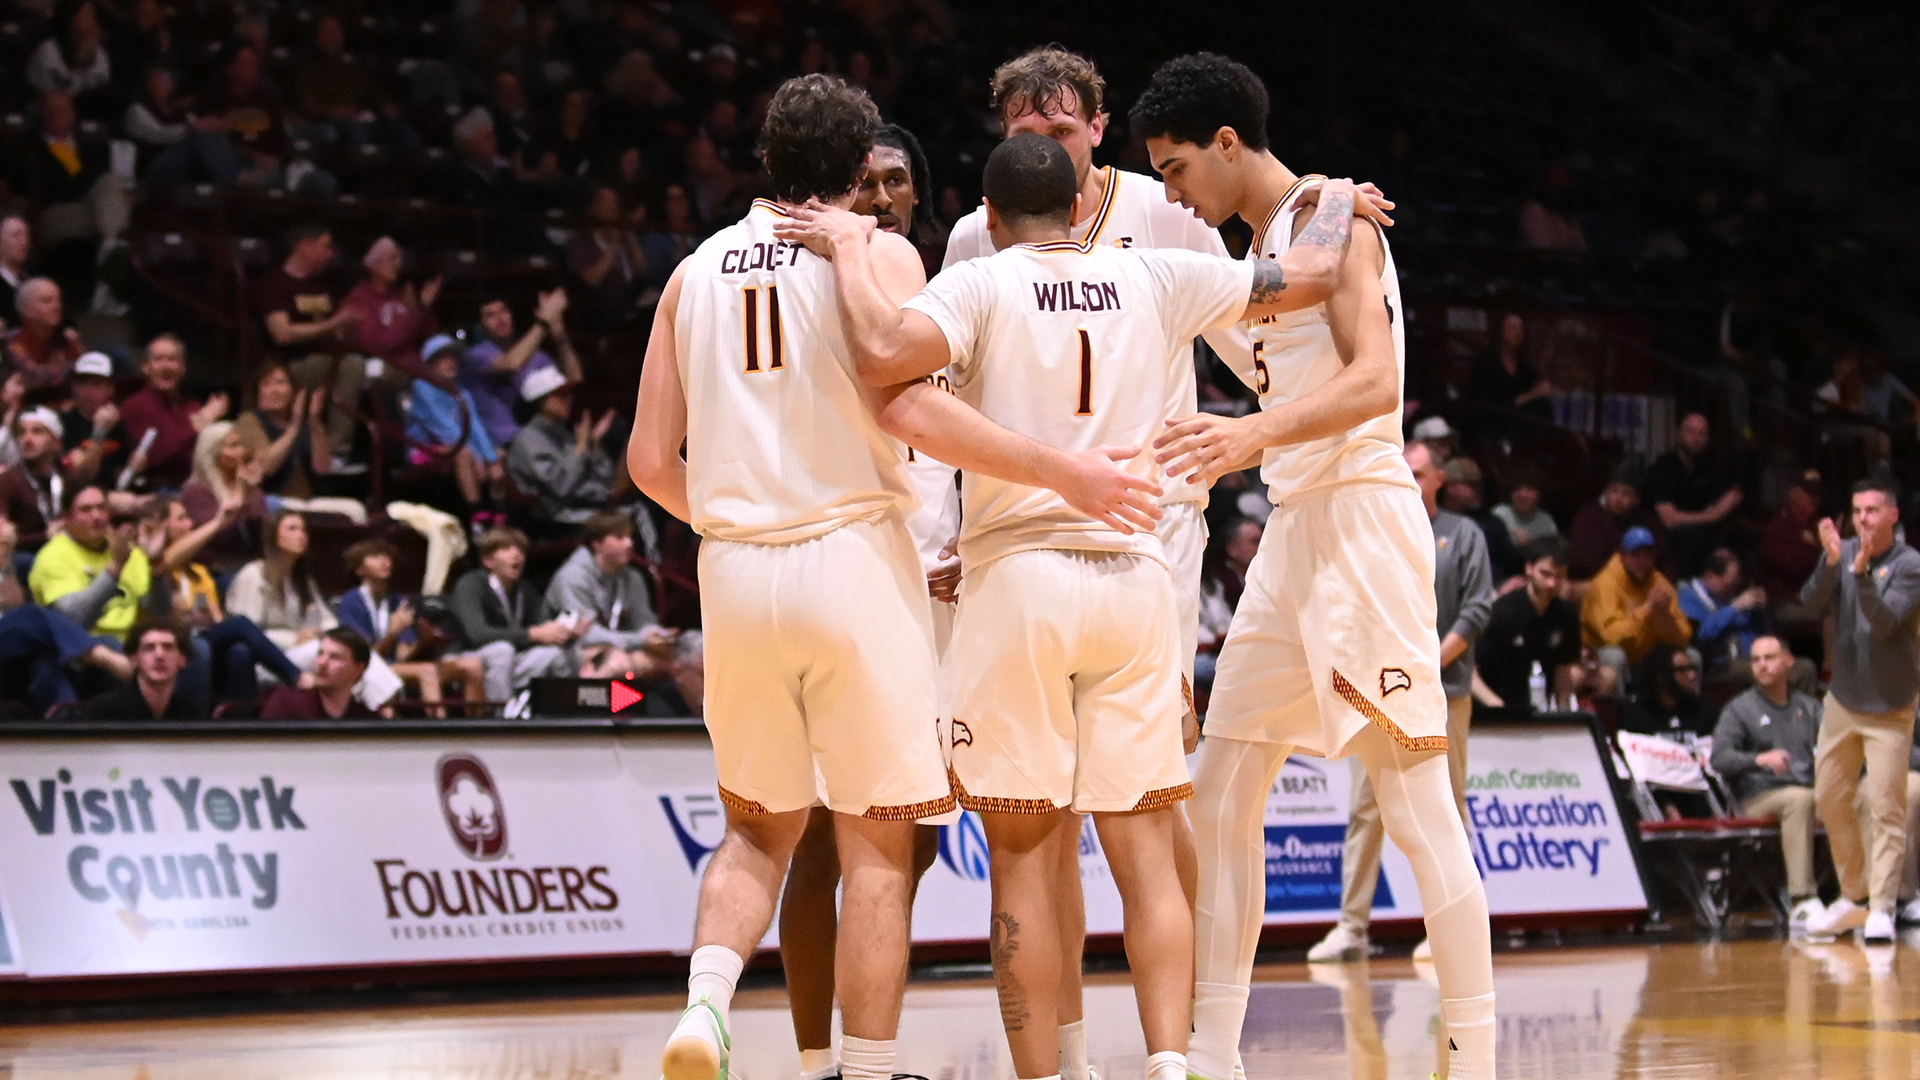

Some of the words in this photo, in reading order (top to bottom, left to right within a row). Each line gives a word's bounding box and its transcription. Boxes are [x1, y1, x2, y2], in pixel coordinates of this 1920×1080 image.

[741, 284, 786, 374] 11
[1074, 327, 1094, 417] 1
[9, 767, 156, 835] Visit
[160, 775, 307, 832] York
[1281, 775, 1328, 795] BEATY
[1466, 768, 1508, 790] outh
[1509, 769, 1581, 790] Carolina
[1465, 795, 1607, 829] Education
[67, 842, 279, 910] County
[1477, 832, 1600, 876] Lottery
[373, 858, 619, 919] FOUNDERS
[390, 923, 478, 941] FEDERAL
[487, 919, 556, 937] CREDIT
[566, 917, 624, 935] UNION
